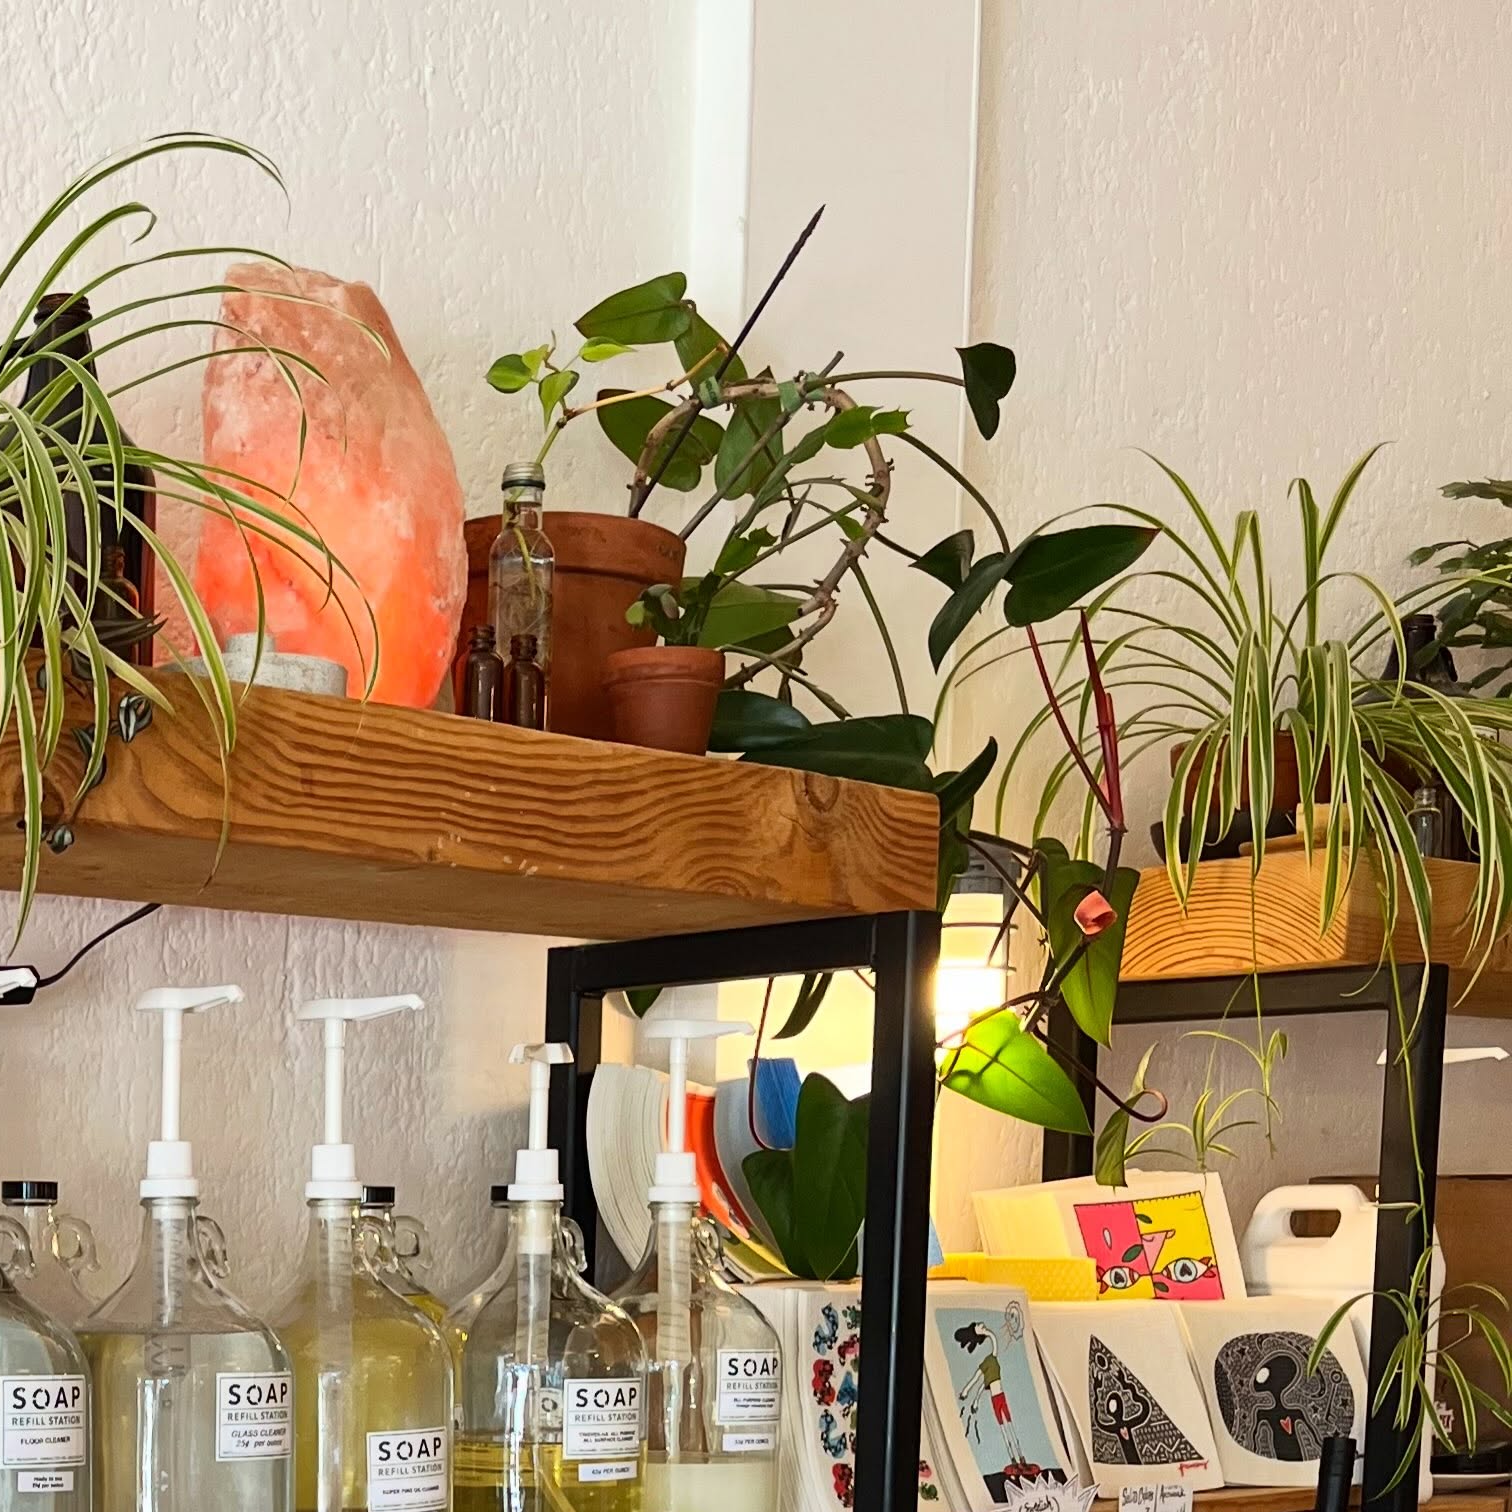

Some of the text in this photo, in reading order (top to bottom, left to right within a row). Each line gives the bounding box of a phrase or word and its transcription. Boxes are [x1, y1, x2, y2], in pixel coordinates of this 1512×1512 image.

[728, 1357, 778, 1376] SOAP
[12, 1386, 81, 1409] SOAP
[228, 1382, 287, 1405] SOAP
[576, 1387, 637, 1408] SOAP
[12, 1415, 81, 1426] REFILL STATION
[228, 1410, 288, 1421] REFILL STATION
[574, 1412, 637, 1422] REFILL STATION
[231, 1430, 258, 1438] GLASS
[378, 1437, 442, 1461] SOAP
[378, 1463, 442, 1476] REFILL STATION
